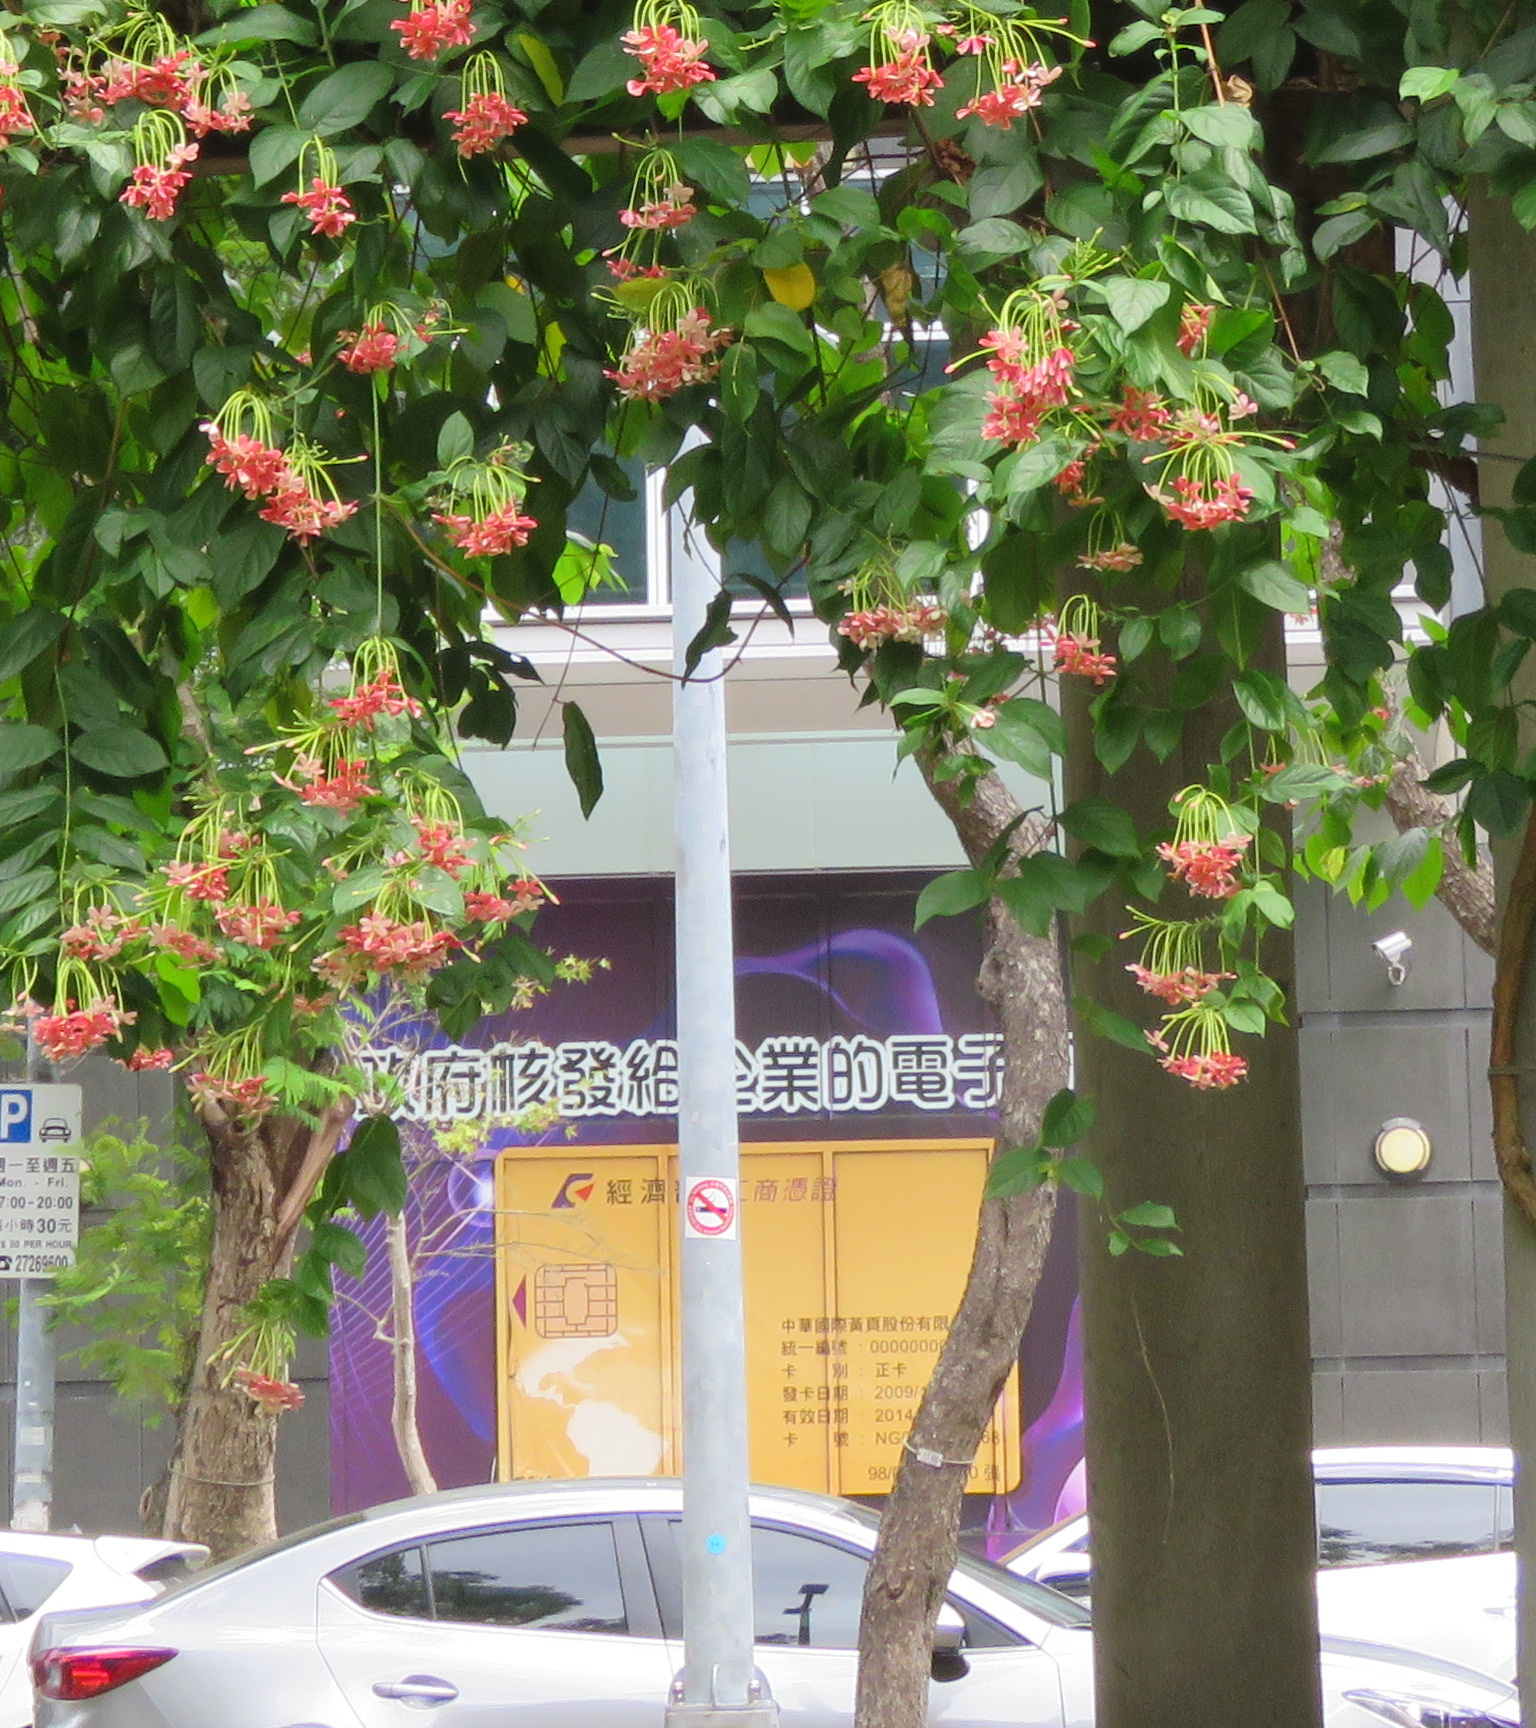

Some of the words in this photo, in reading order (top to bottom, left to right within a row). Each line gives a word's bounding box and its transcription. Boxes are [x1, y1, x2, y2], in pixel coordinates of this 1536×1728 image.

[0, 1094, 28, 1139] P
[47, 1177, 68, 1188] Fri.
[606, 1179, 682, 1205] 經濟
[23, 1240, 42, 1248] PER
[45, 1240, 72, 1249] HOUR
